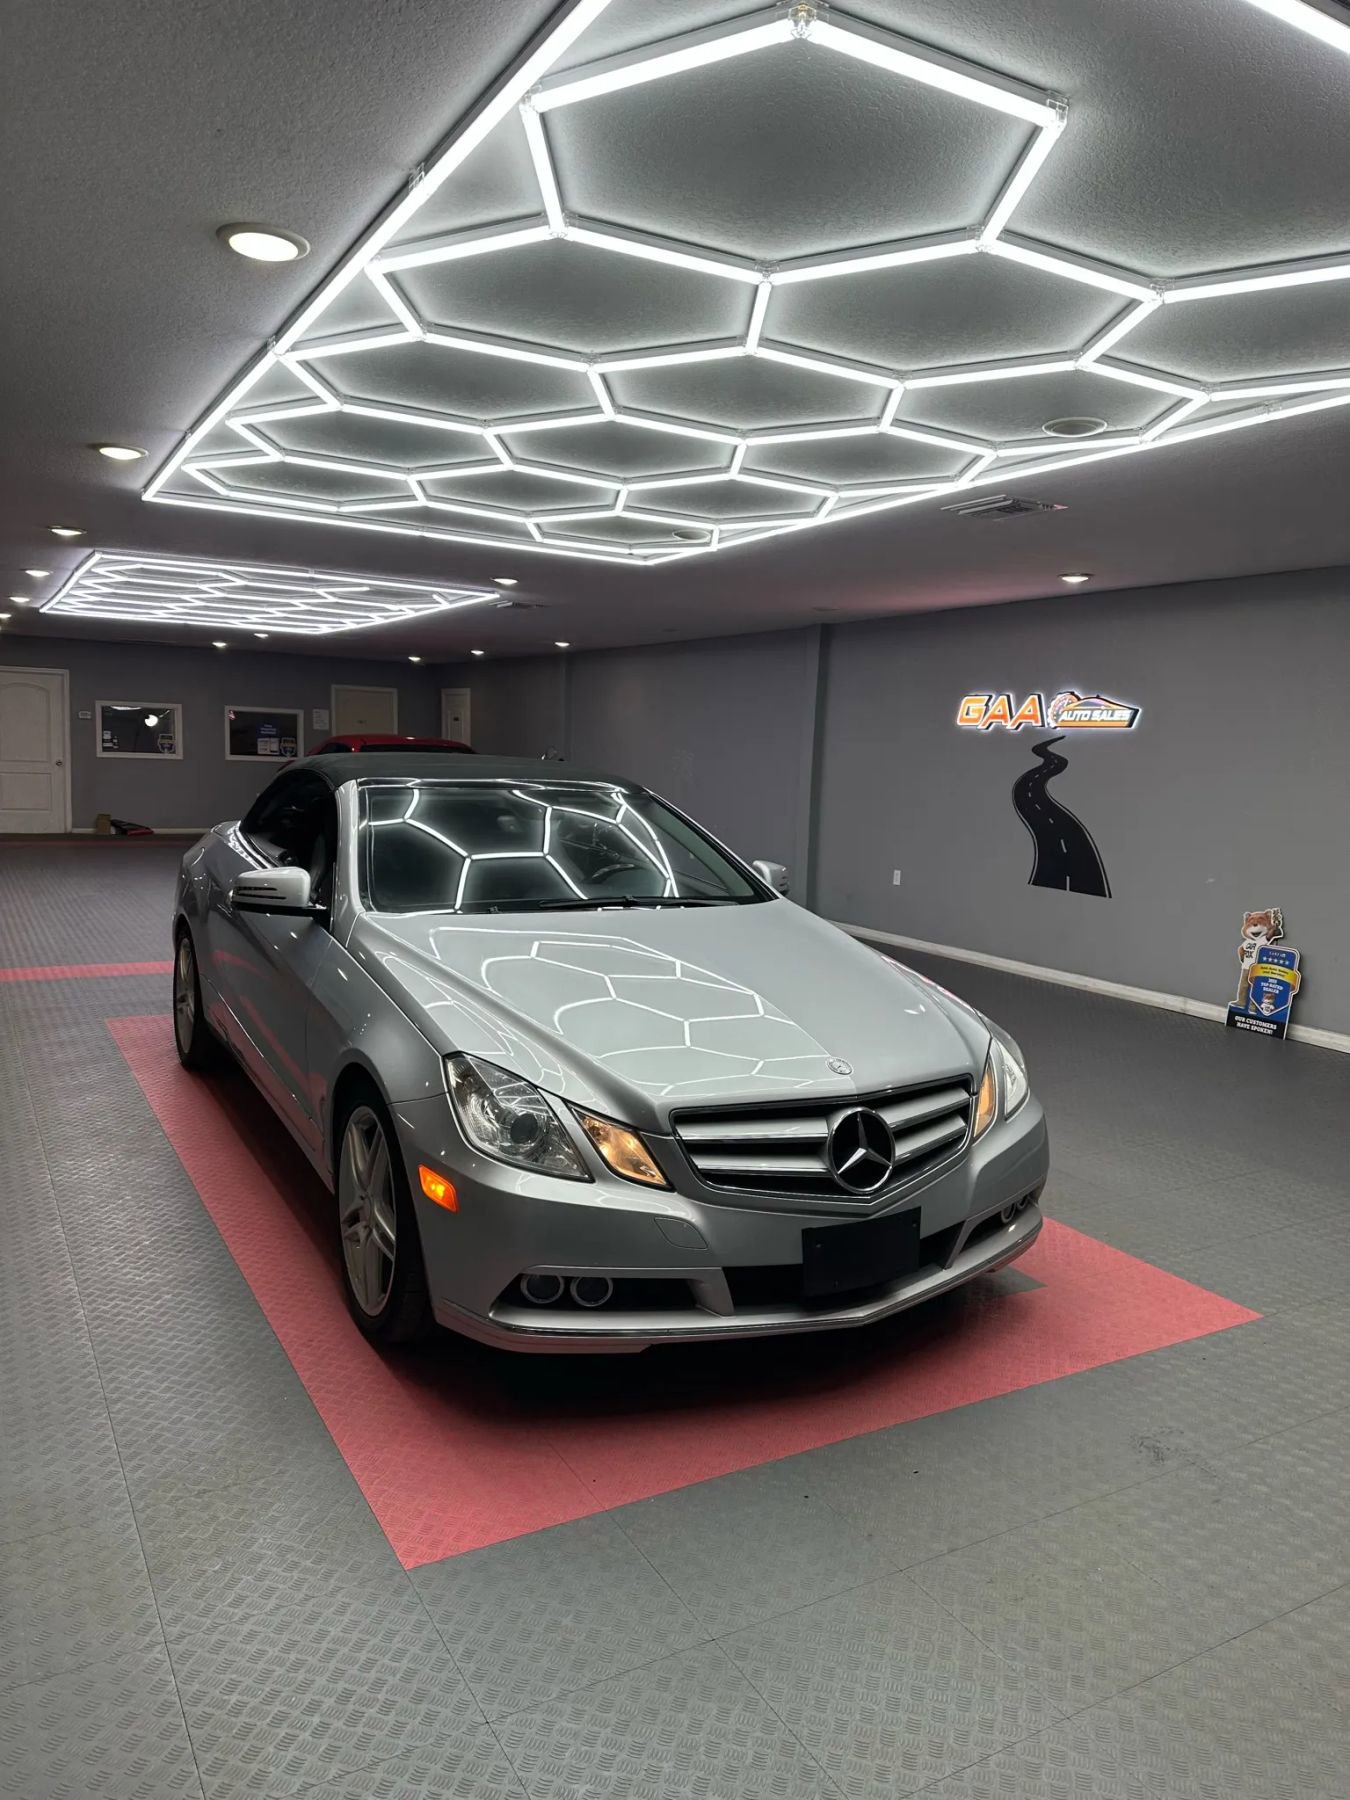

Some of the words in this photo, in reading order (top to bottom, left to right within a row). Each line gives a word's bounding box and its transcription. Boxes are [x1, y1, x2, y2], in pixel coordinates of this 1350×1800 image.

[957, 694, 1045, 730] GAA
[1059, 710, 1089, 722] AUTO
[1091, 709, 1132, 722] SALES
[1234, 1015, 1245, 1023] OUR
[1246, 1017, 1277, 1030] CUSTOMERS
